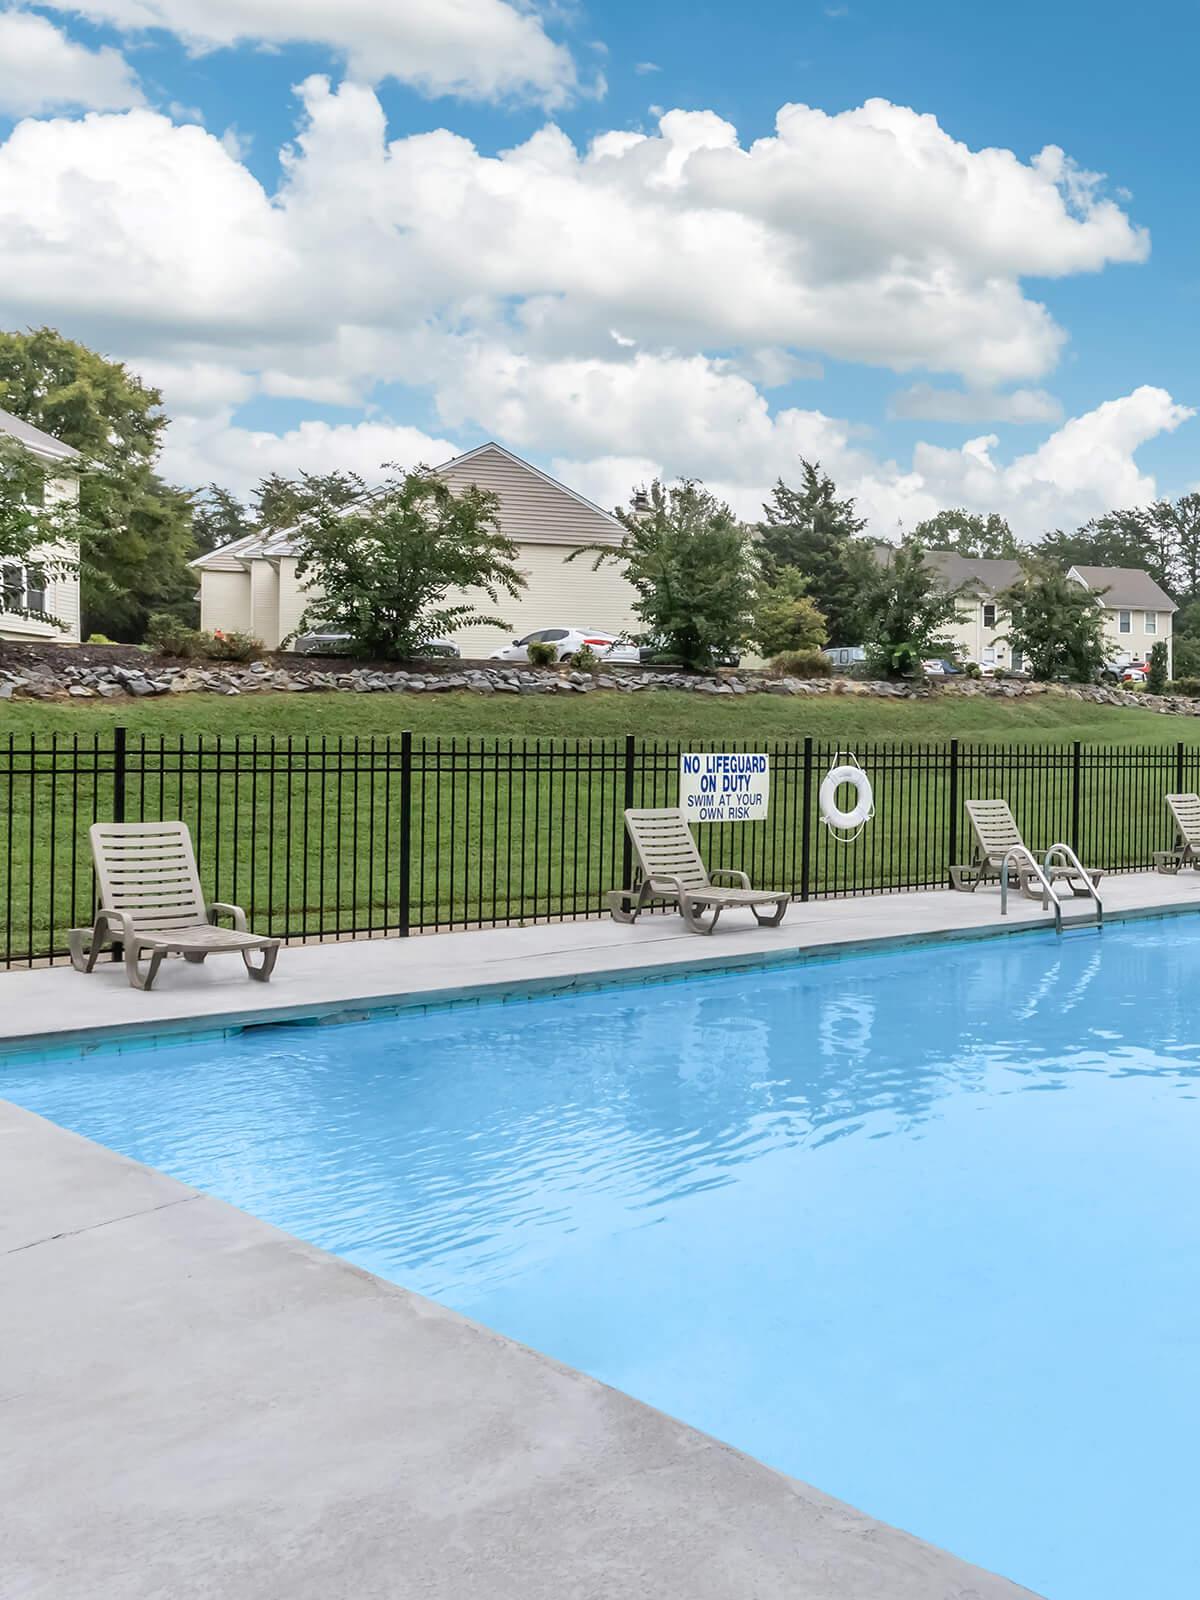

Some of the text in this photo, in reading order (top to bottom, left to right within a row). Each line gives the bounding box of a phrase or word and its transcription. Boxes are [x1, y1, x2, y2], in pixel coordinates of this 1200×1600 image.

[684, 756, 766, 773] NO LIFEGUARD
[700, 775, 751, 793] ON DUTY
[687, 793, 762, 807] SWIM AT YOUR
[699, 807, 750, 820] OWN RISK
